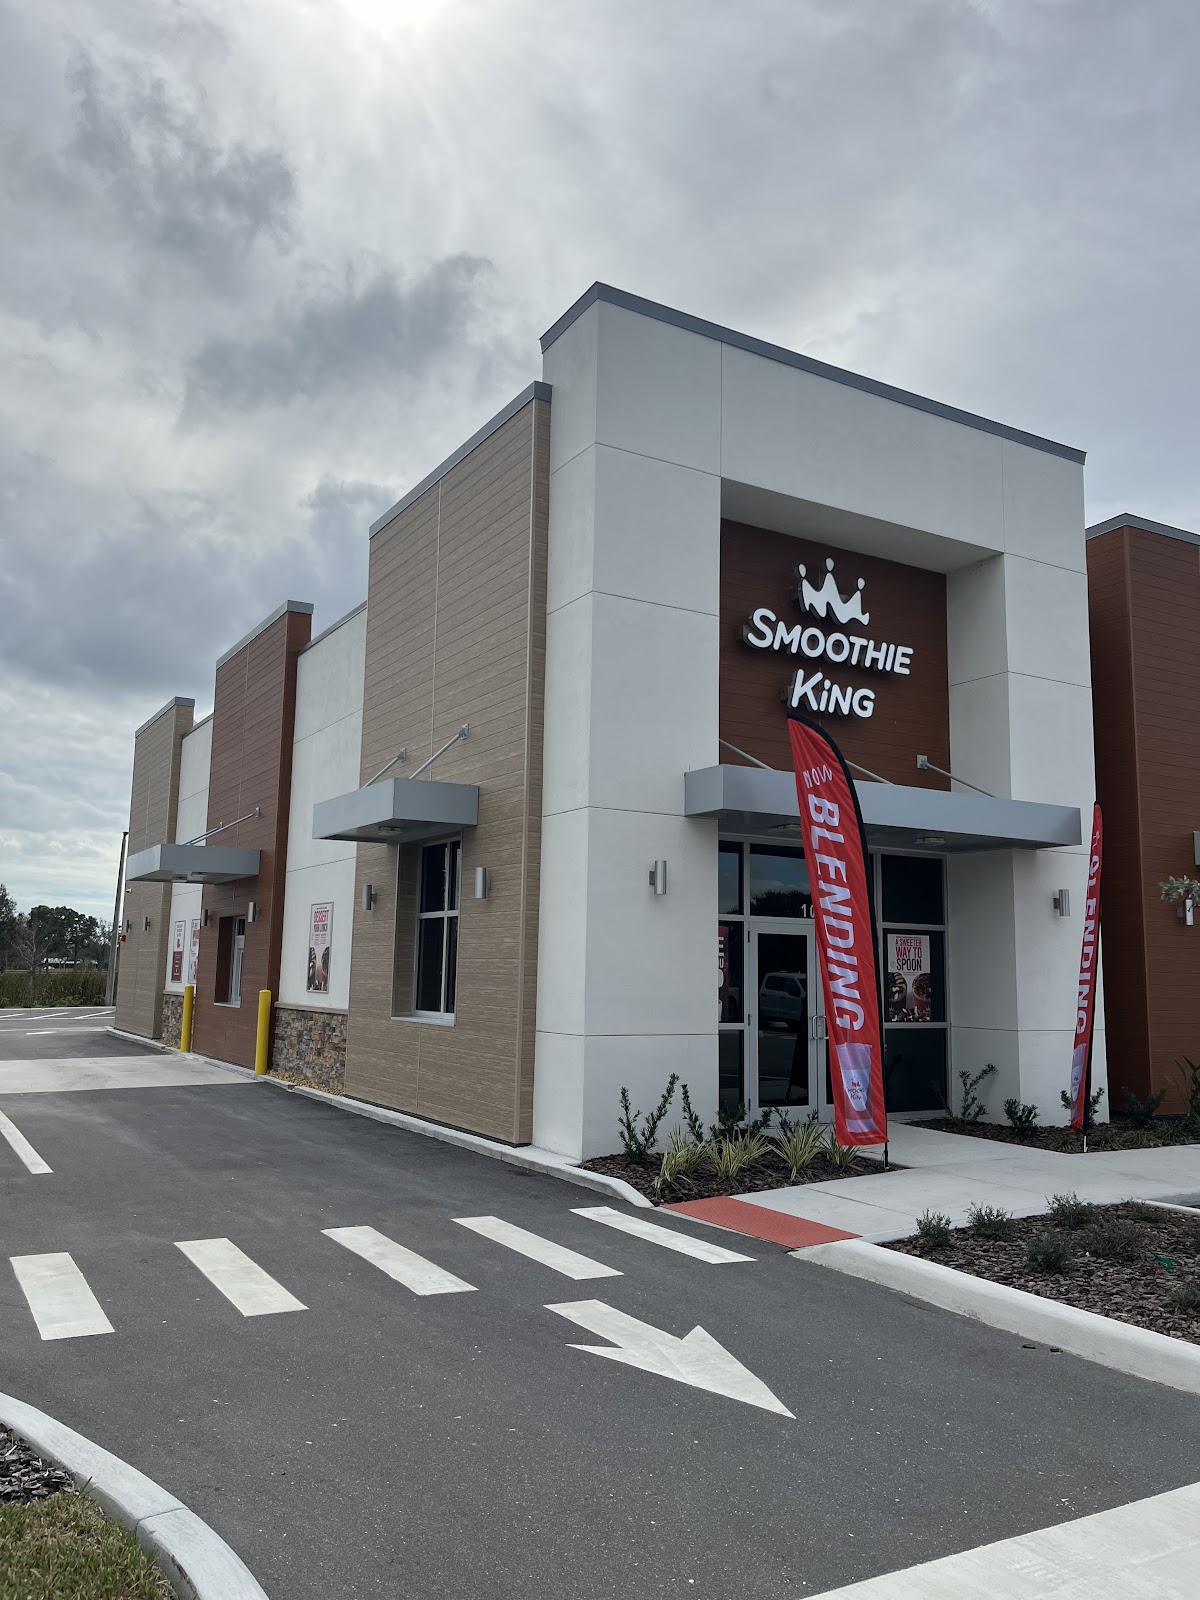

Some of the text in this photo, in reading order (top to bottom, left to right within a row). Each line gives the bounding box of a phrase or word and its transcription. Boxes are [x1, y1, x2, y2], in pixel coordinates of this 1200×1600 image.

[747, 608, 914, 675] SMOOTHIE
[802, 764, 833, 789] NOW
[807, 794, 865, 1031] BLENDING
[896, 946, 922, 958] WAY TO
[900, 938, 922, 947] SWEETER
[896, 958, 922, 971] SPOON
